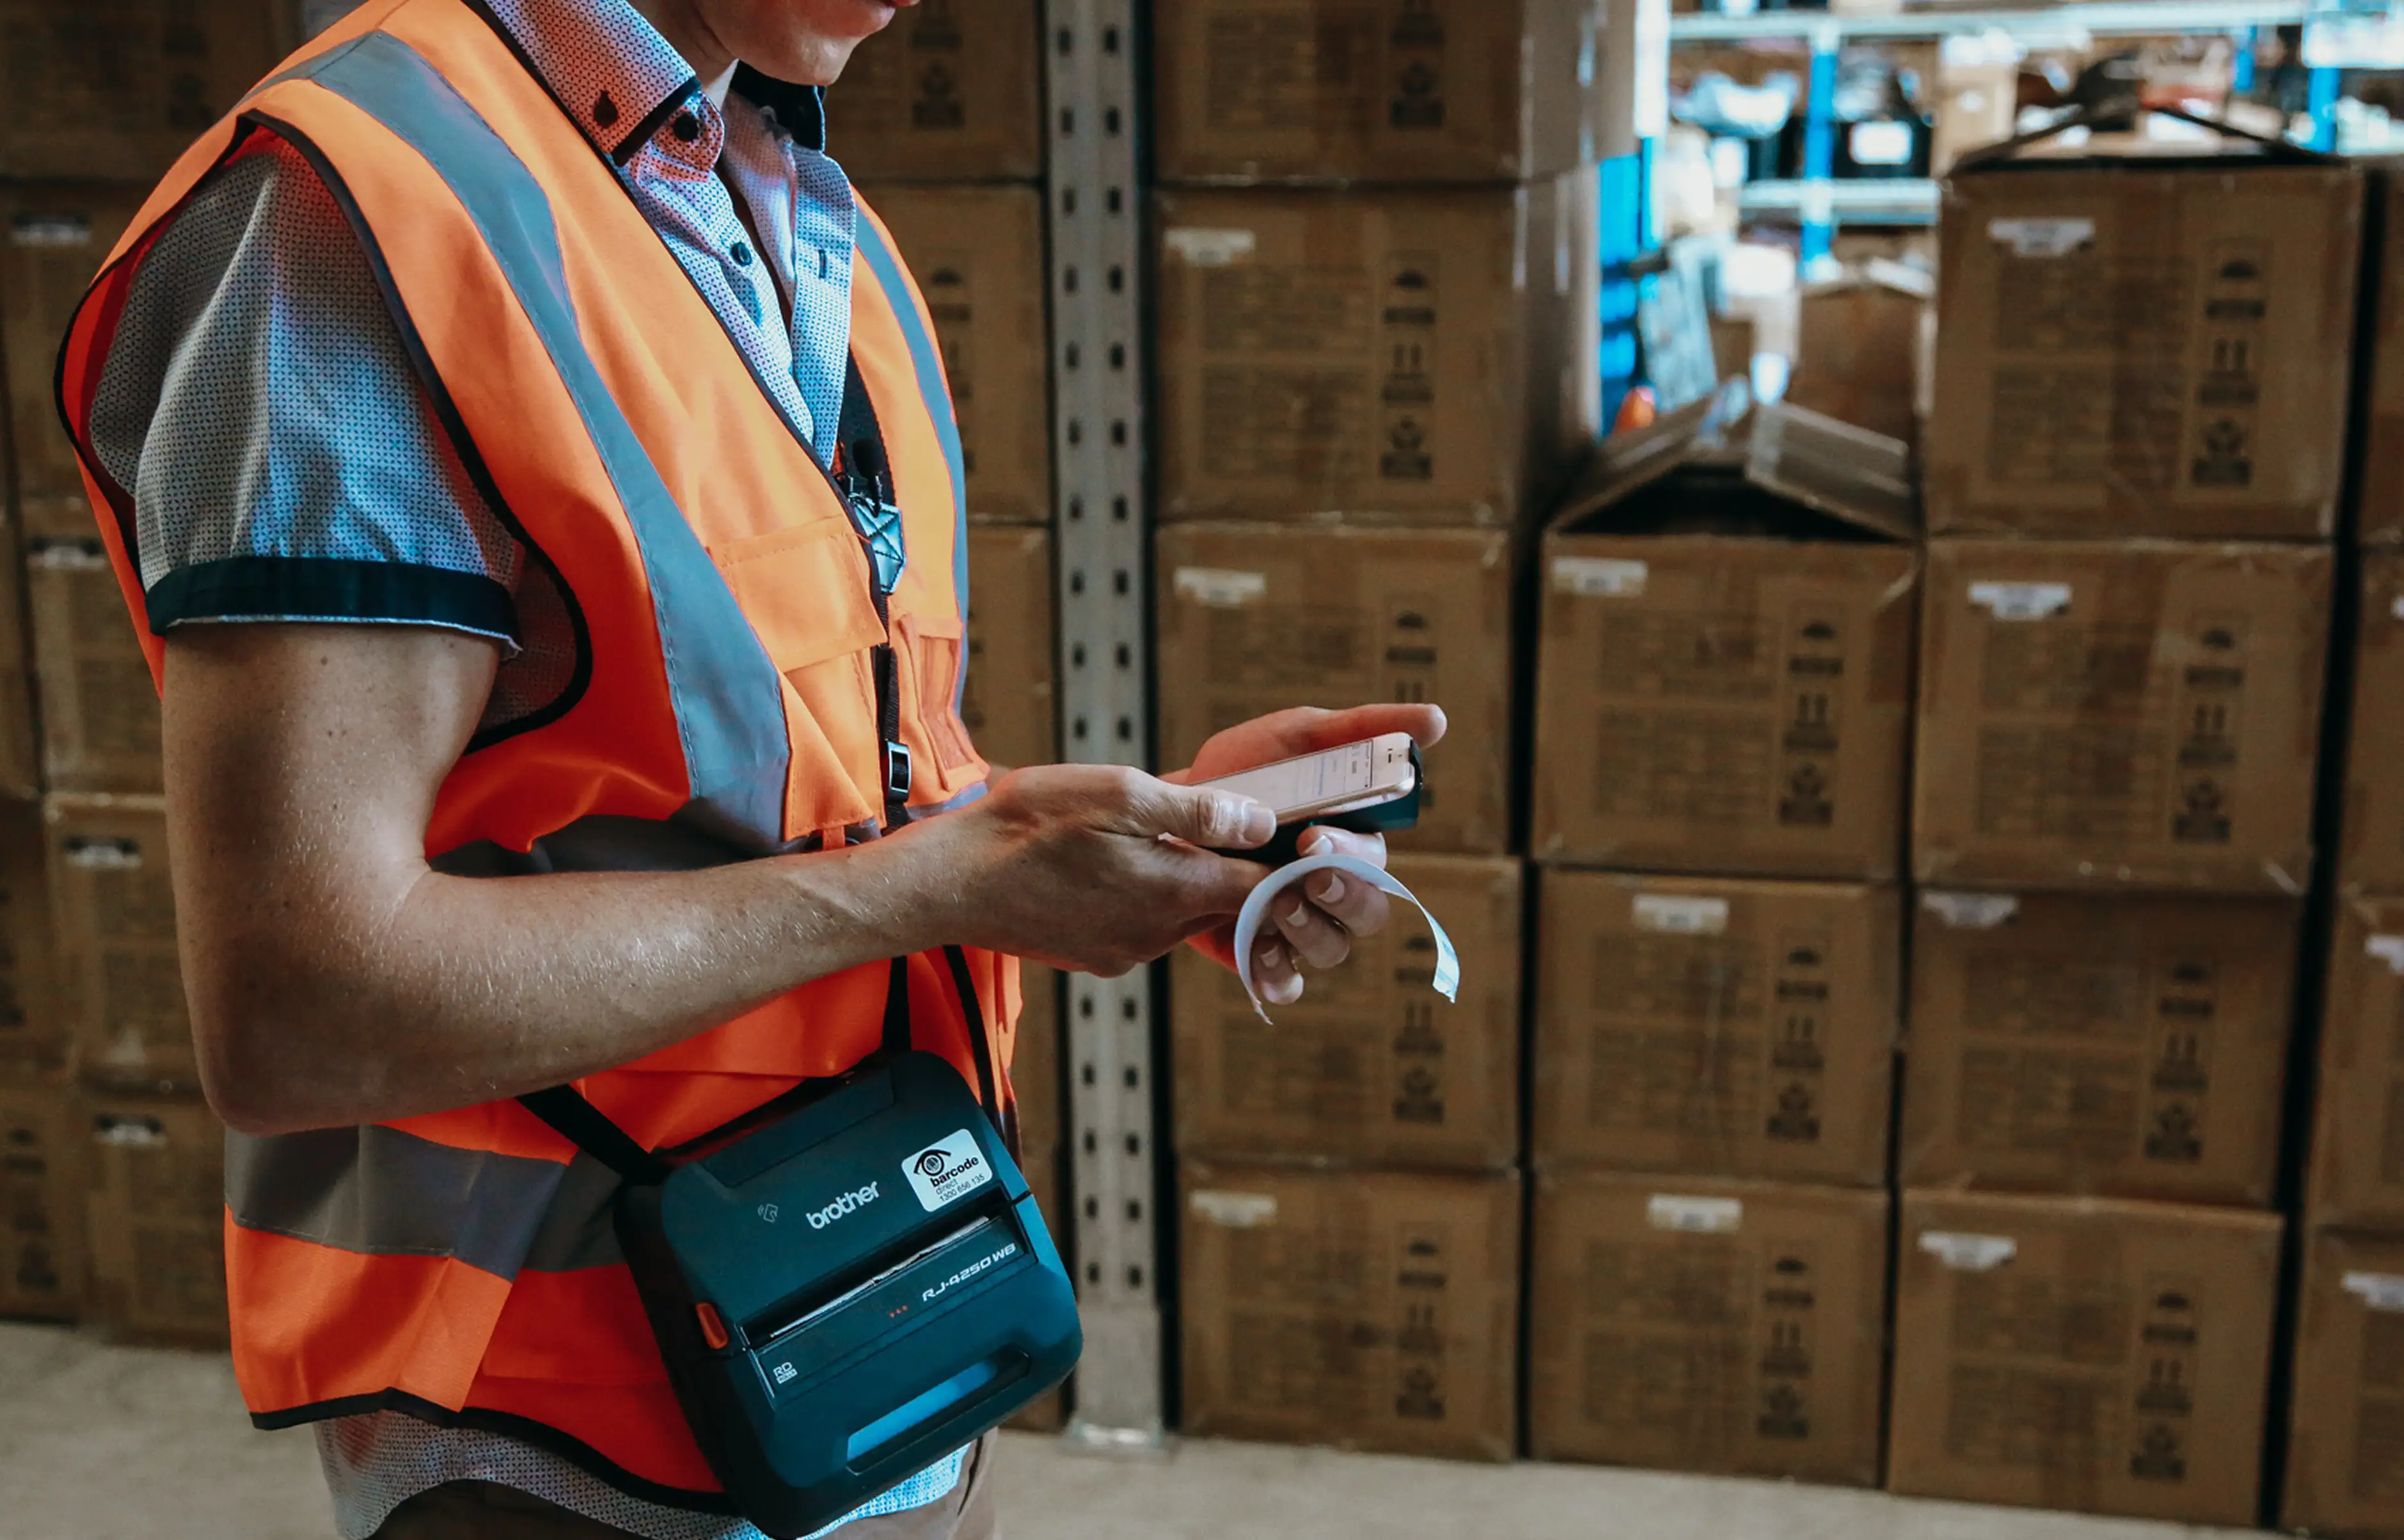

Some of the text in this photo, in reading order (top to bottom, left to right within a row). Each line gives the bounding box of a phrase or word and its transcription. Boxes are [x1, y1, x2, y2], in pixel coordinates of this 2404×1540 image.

[930, 1157, 979, 1187] barcode
[936, 1179, 958, 1195] direct
[805, 1181, 879, 1229] brother
[773, 1362, 793, 1377] RD
